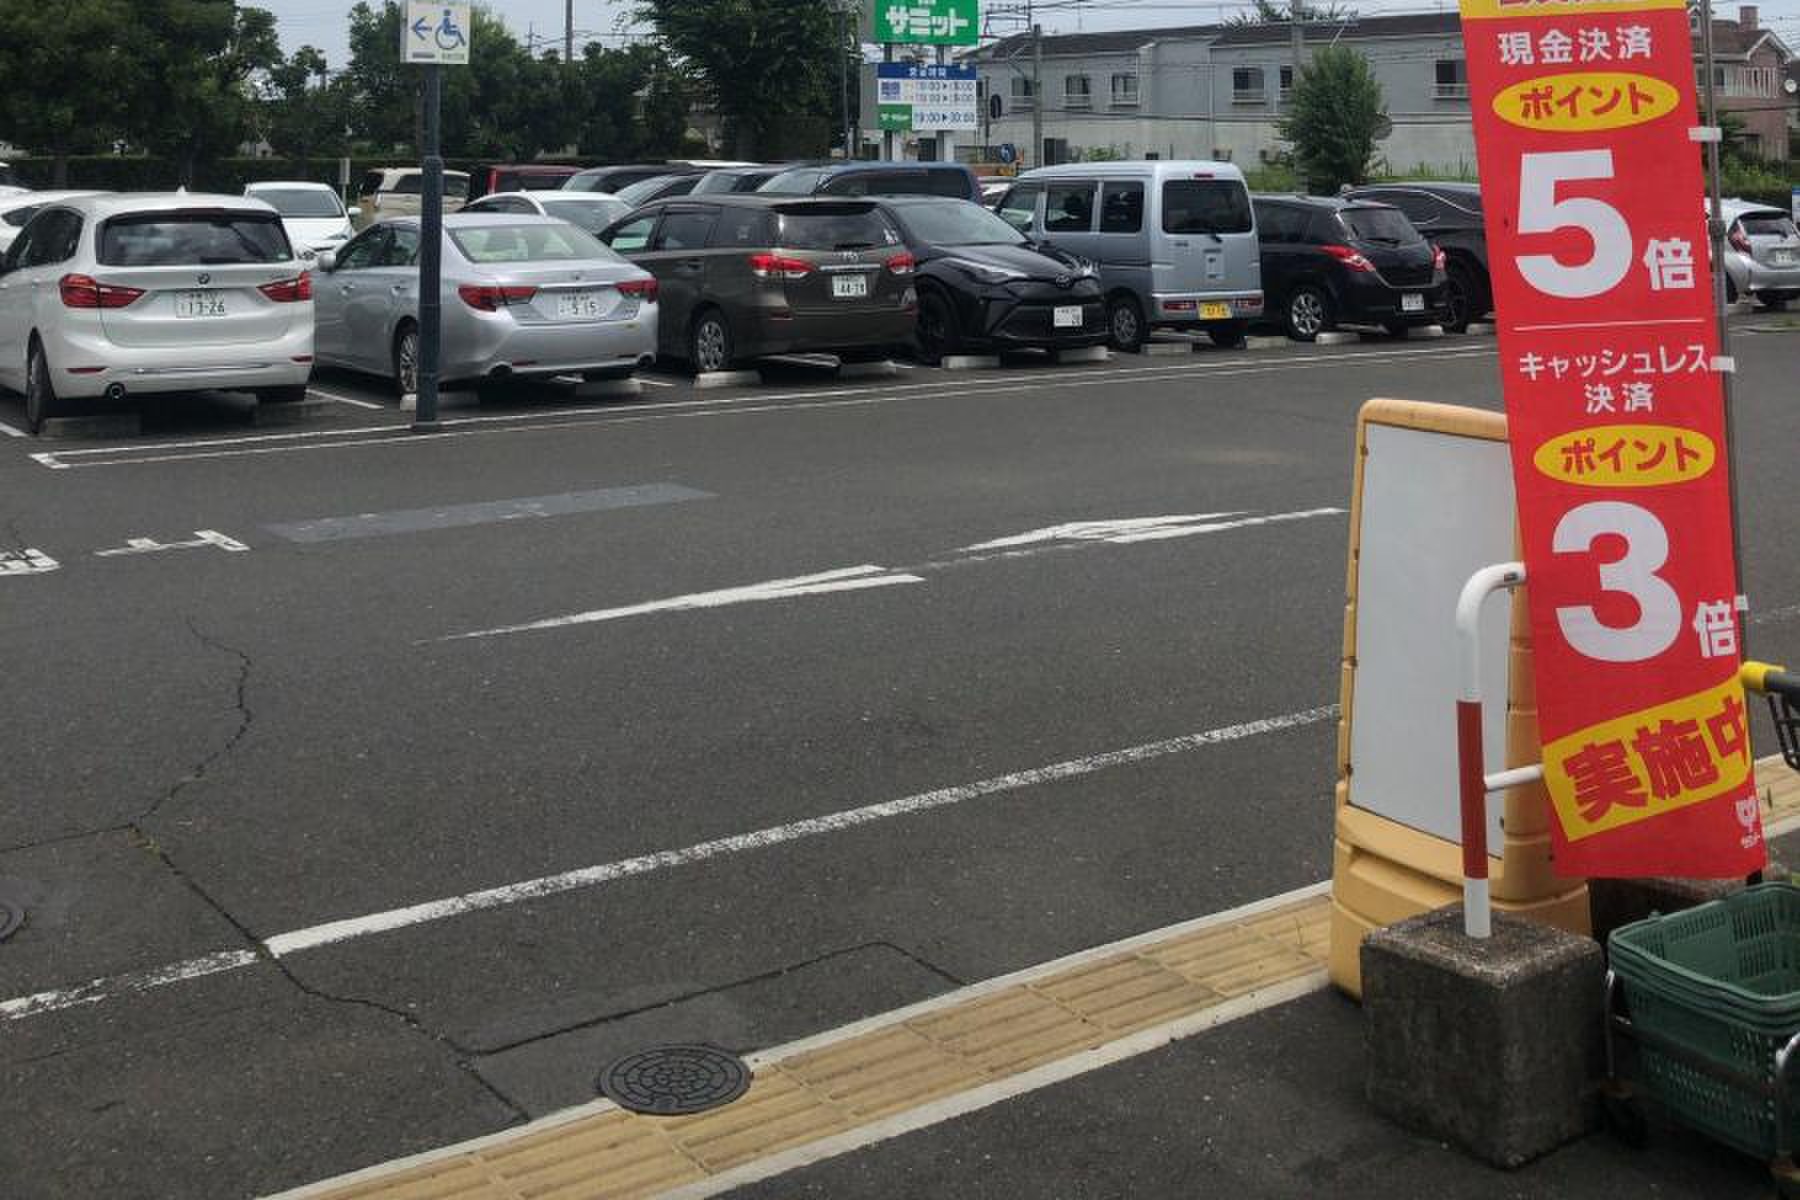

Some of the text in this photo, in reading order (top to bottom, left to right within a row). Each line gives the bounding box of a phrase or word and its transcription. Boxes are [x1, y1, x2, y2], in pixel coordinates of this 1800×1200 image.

[885, 5, 969, 37] サミット
[1498, 25, 1652, 66] 現金決済
[1519, 81, 1655, 121] ポイント
[1520, 345, 1709, 381] キャッシュレス
[1585, 383, 1654, 414] 決済
[1561, 436, 1700, 474] ポイント
